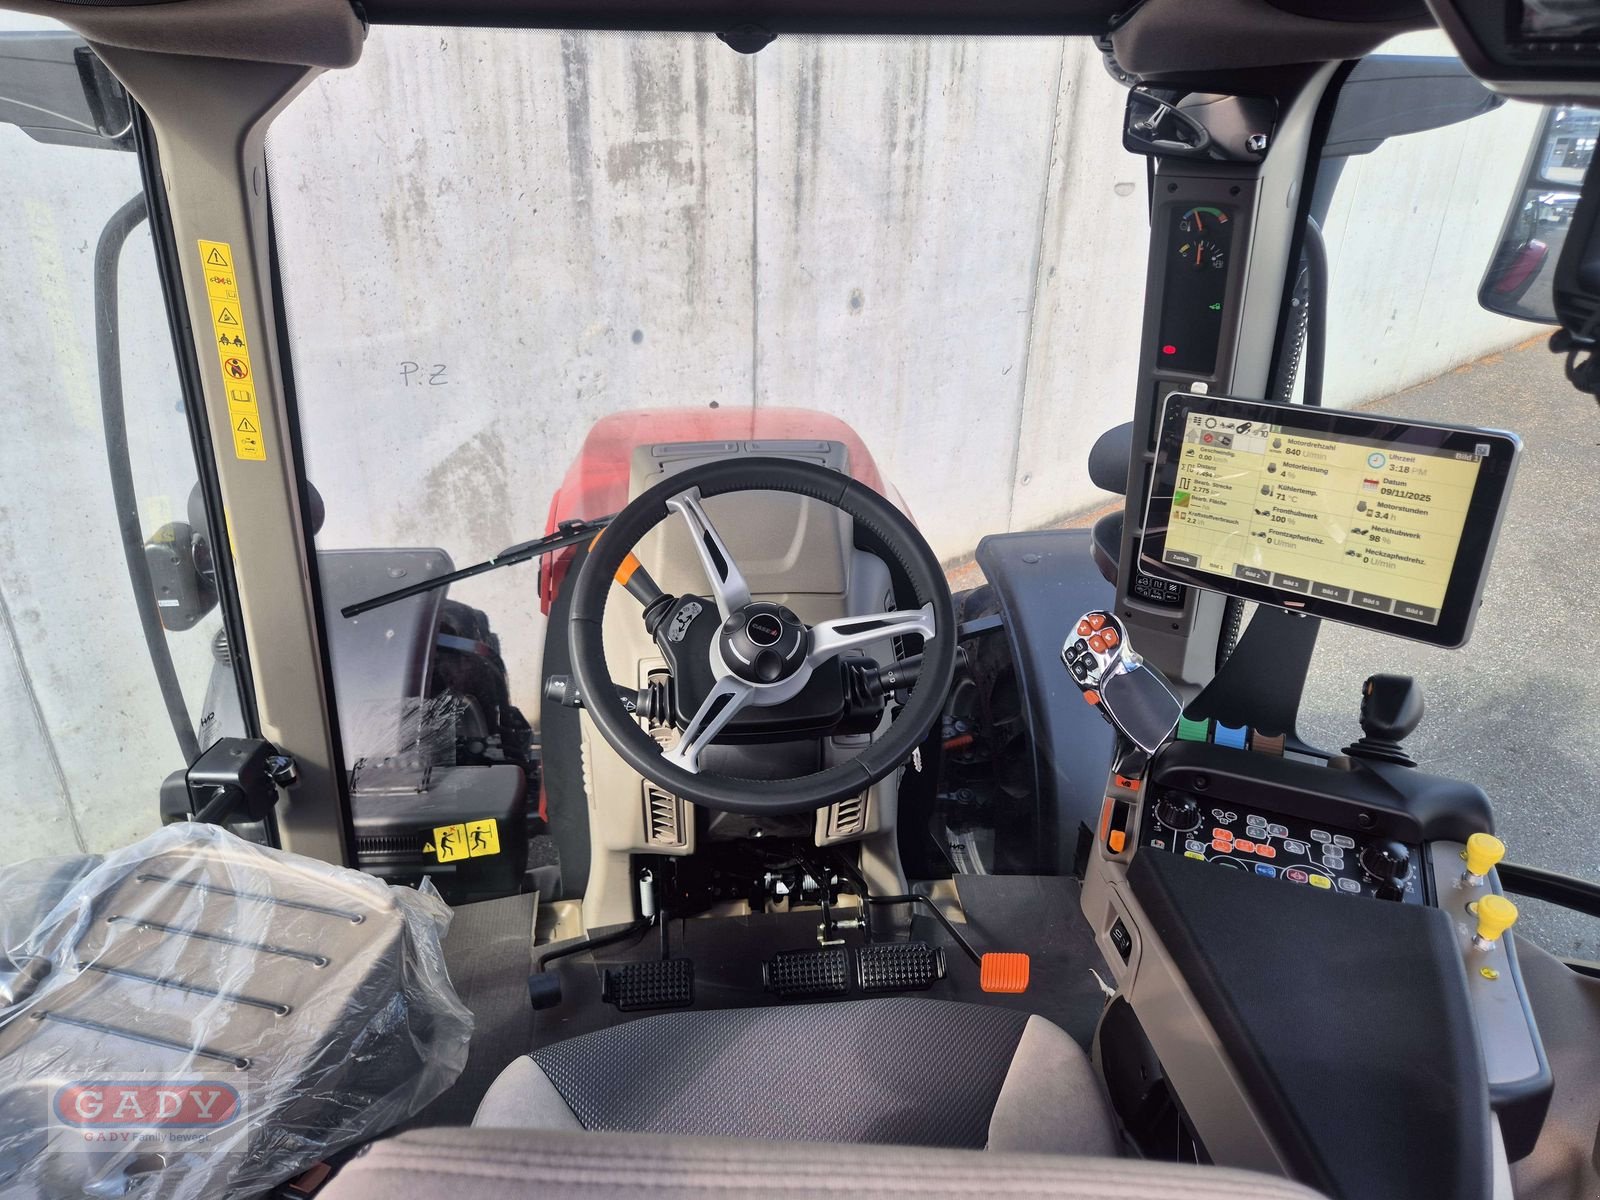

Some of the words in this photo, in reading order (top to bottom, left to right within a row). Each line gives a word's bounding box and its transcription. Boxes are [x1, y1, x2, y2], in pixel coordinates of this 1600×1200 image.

[1288, 438, 1336, 450] Motordrehzahl
[1285, 448, 1301, 456] 840
[1389, 452, 1416, 464] Uhrzeit
[1282, 462, 1329, 476] Motorleistung
[1389, 464, 1410, 474] 3:18
[1382, 478, 1407, 487] Datum
[1278, 484, 1318, 496] Kühlertemp.
[1380, 487, 1432, 502] 09/11/2025
[1276, 492, 1286, 501] 71
[1272, 506, 1318, 520] Fronthubwerk
[1377, 501, 1429, 516] Motorstunden
[1270, 514, 1286, 524] 100
[1374, 512, 1389, 520] 3.4
[1268, 528, 1325, 545] Frontzapfwdrehz.
[1368, 534, 1381, 542] 98
[1371, 525, 1422, 540] Heckhubwerk
[1365, 548, 1426, 565] Heckzapfwdrehz.
[1370, 558, 1396, 569] U/min
